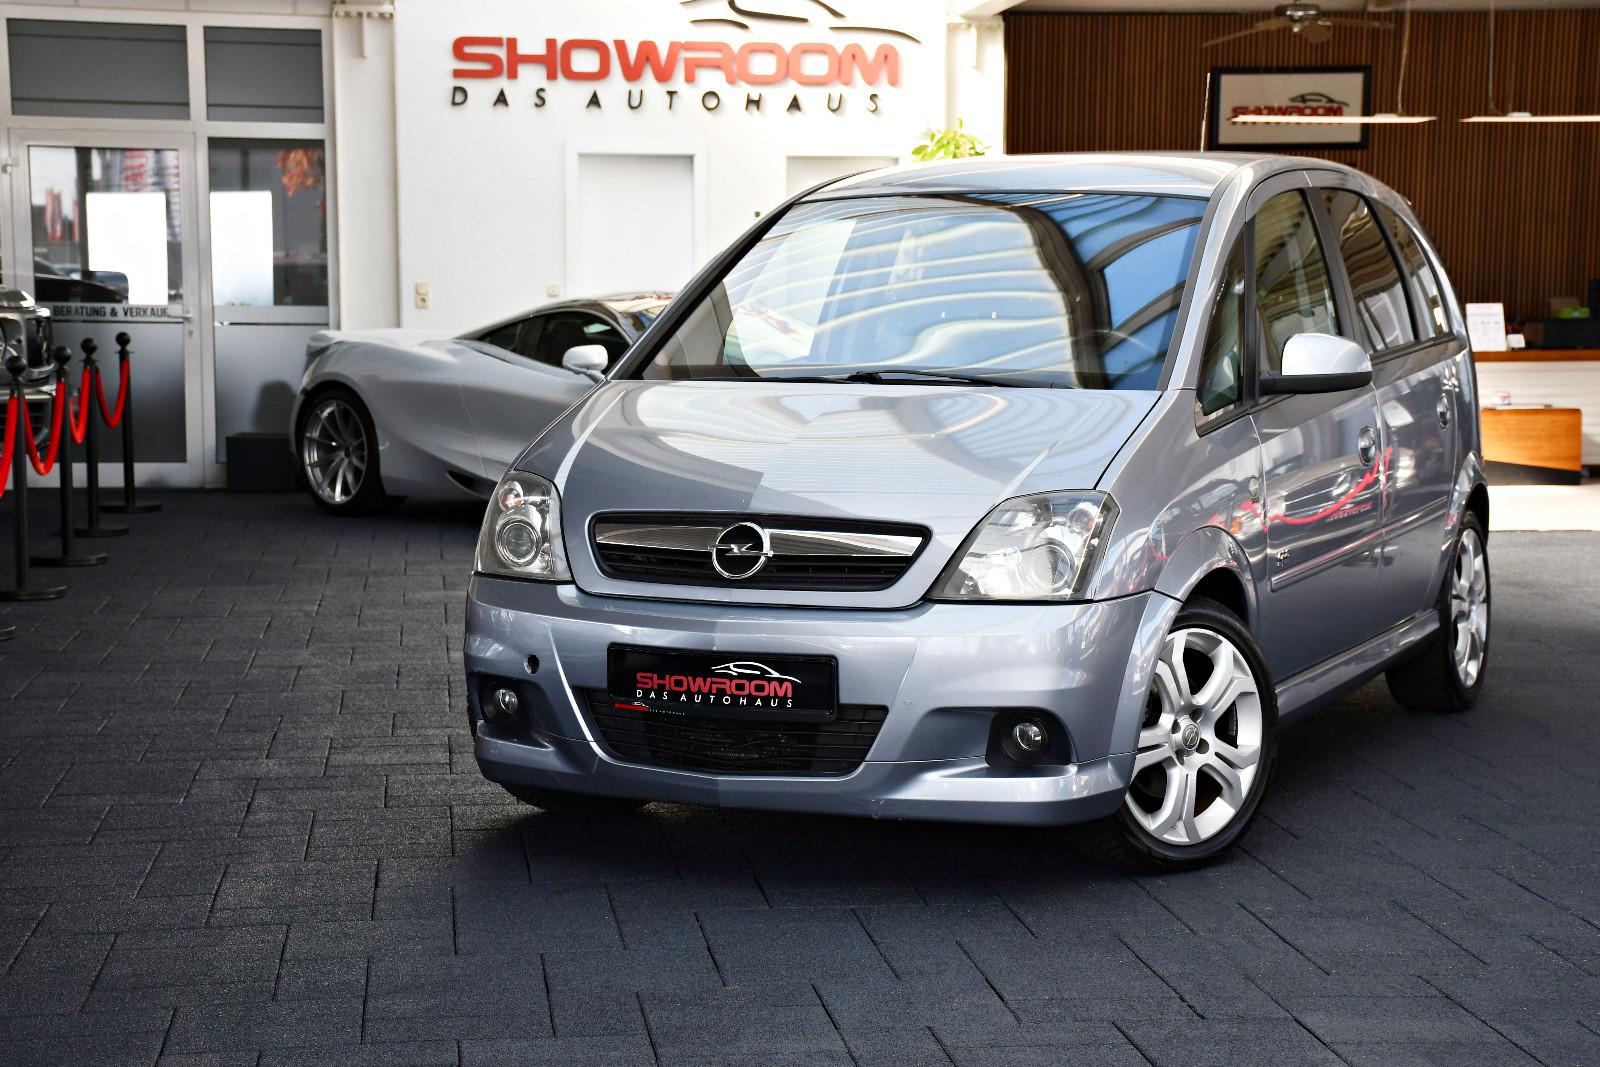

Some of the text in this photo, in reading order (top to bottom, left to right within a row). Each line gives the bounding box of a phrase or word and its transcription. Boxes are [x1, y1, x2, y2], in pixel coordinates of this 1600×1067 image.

[452, 36, 898, 86] SHOWROOM
[451, 87, 880, 113] DAS AUTOHAUS
[53, 305, 168, 318] BERATUNG & VERKAUF
[636, 672, 793, 698] SHOWROOM
[636, 689, 793, 708] DAS AUTOHAUS
